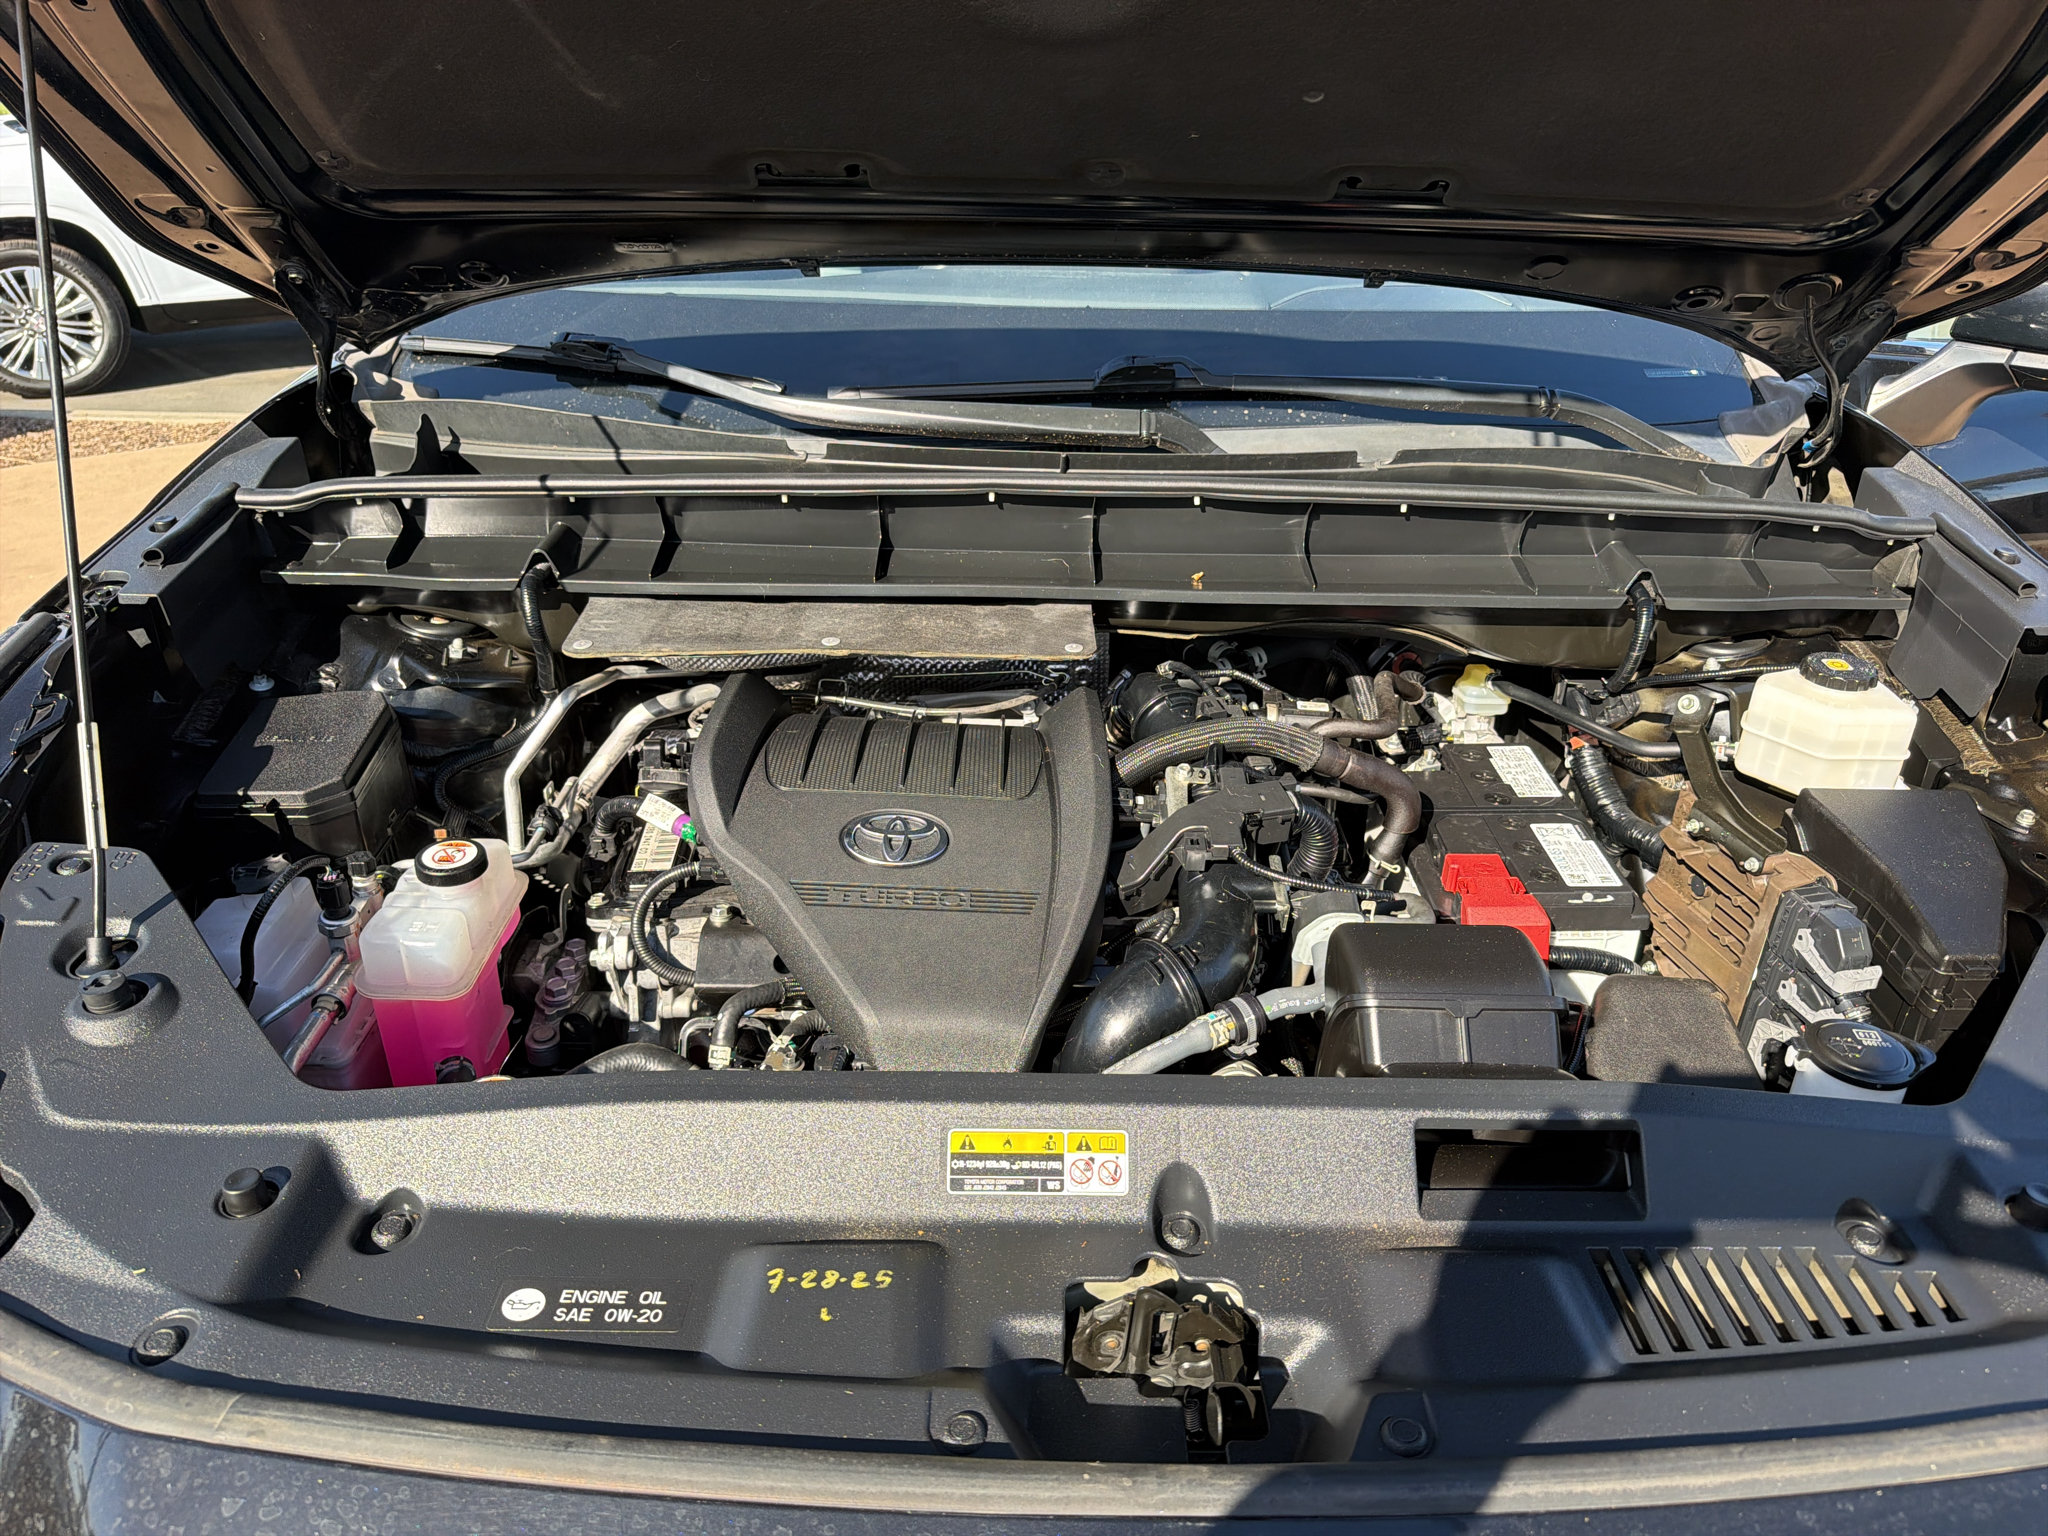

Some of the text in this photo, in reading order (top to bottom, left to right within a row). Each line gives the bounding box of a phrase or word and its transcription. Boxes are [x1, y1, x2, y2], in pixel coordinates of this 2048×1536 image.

[830, 887, 969, 908] TURBO
[766, 1267, 894, 1294] 7-28-25
[559, 1289, 668, 1305] ENGINE OIL
[553, 1307, 663, 1323] SAE 0W-20
